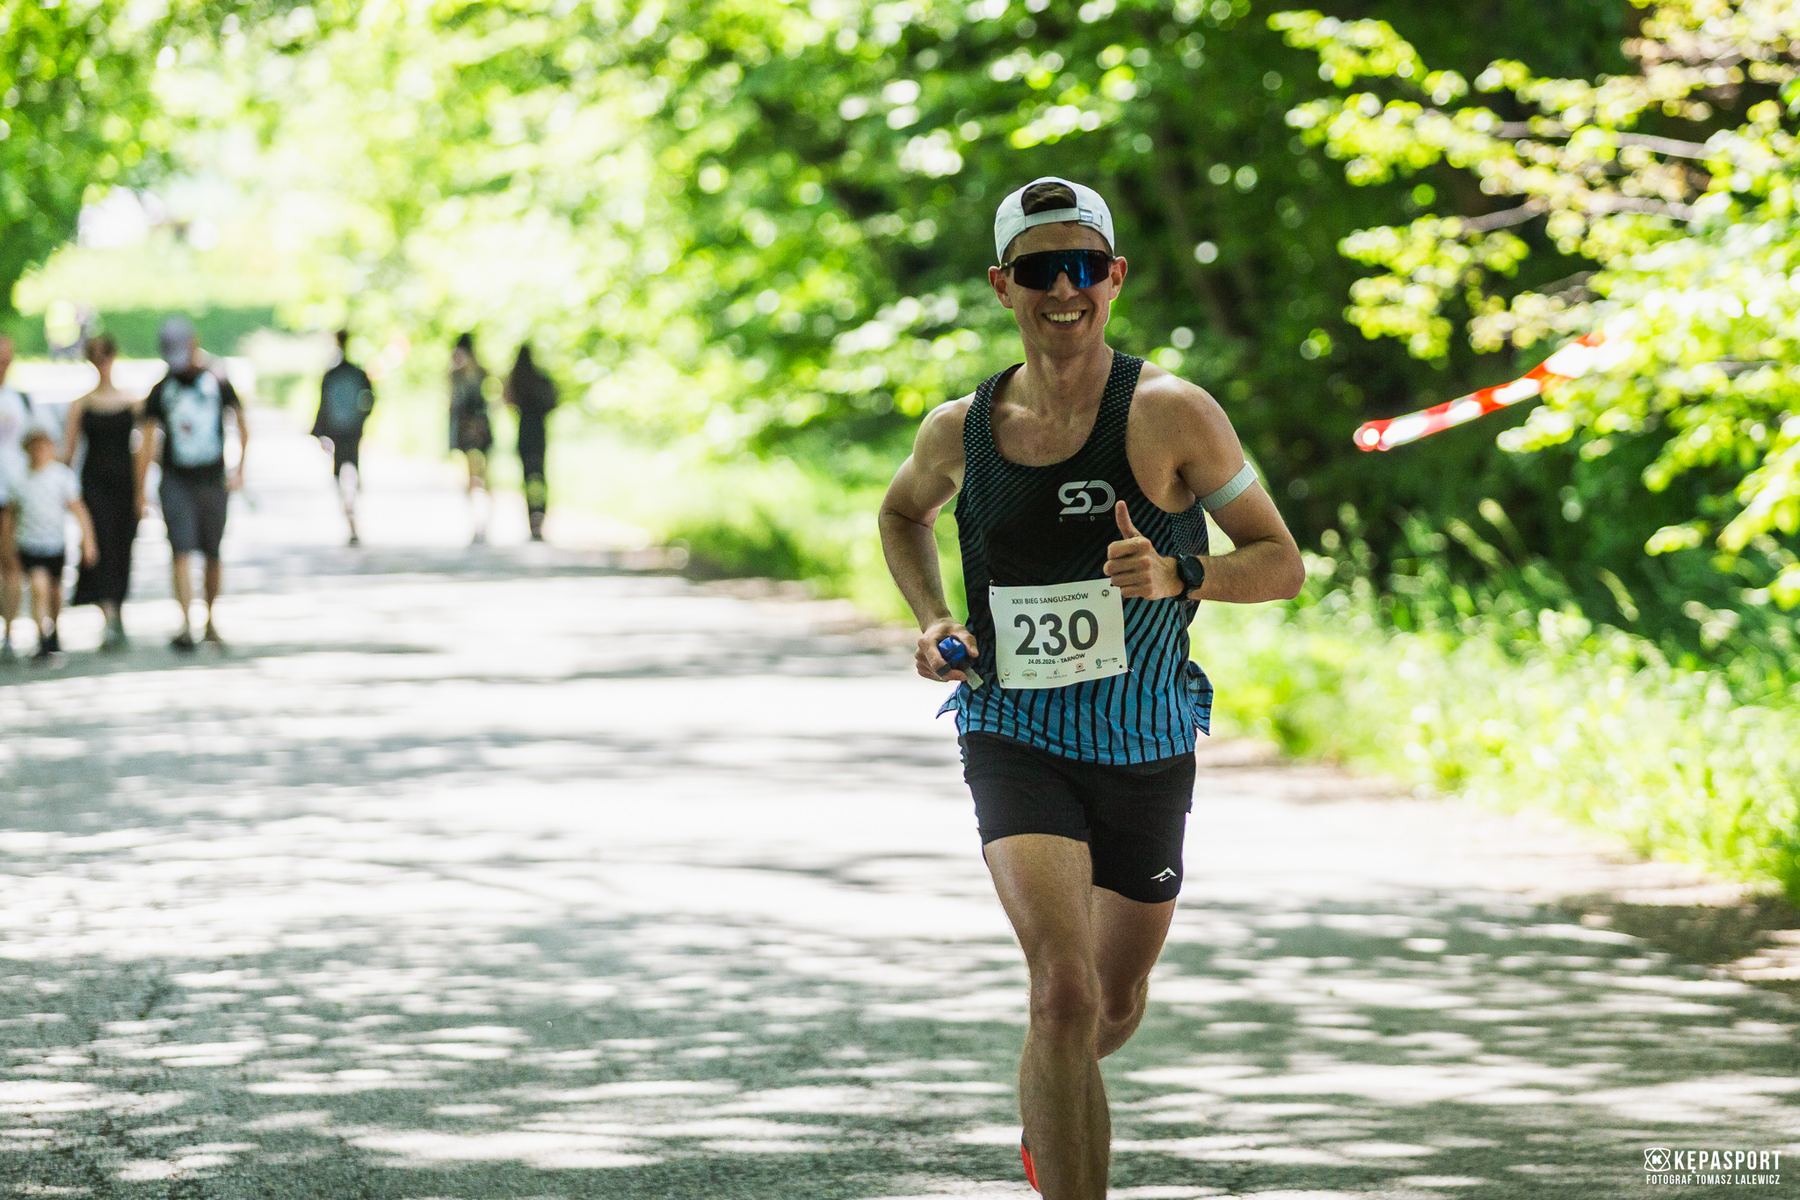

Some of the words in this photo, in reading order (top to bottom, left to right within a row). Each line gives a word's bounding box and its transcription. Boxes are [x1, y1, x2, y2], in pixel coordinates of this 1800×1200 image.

[1039, 592, 1089, 604] SANGUSZKÓW
[1014, 609, 1099, 656] 230
[1060, 653, 1086, 663] TARNÓW
